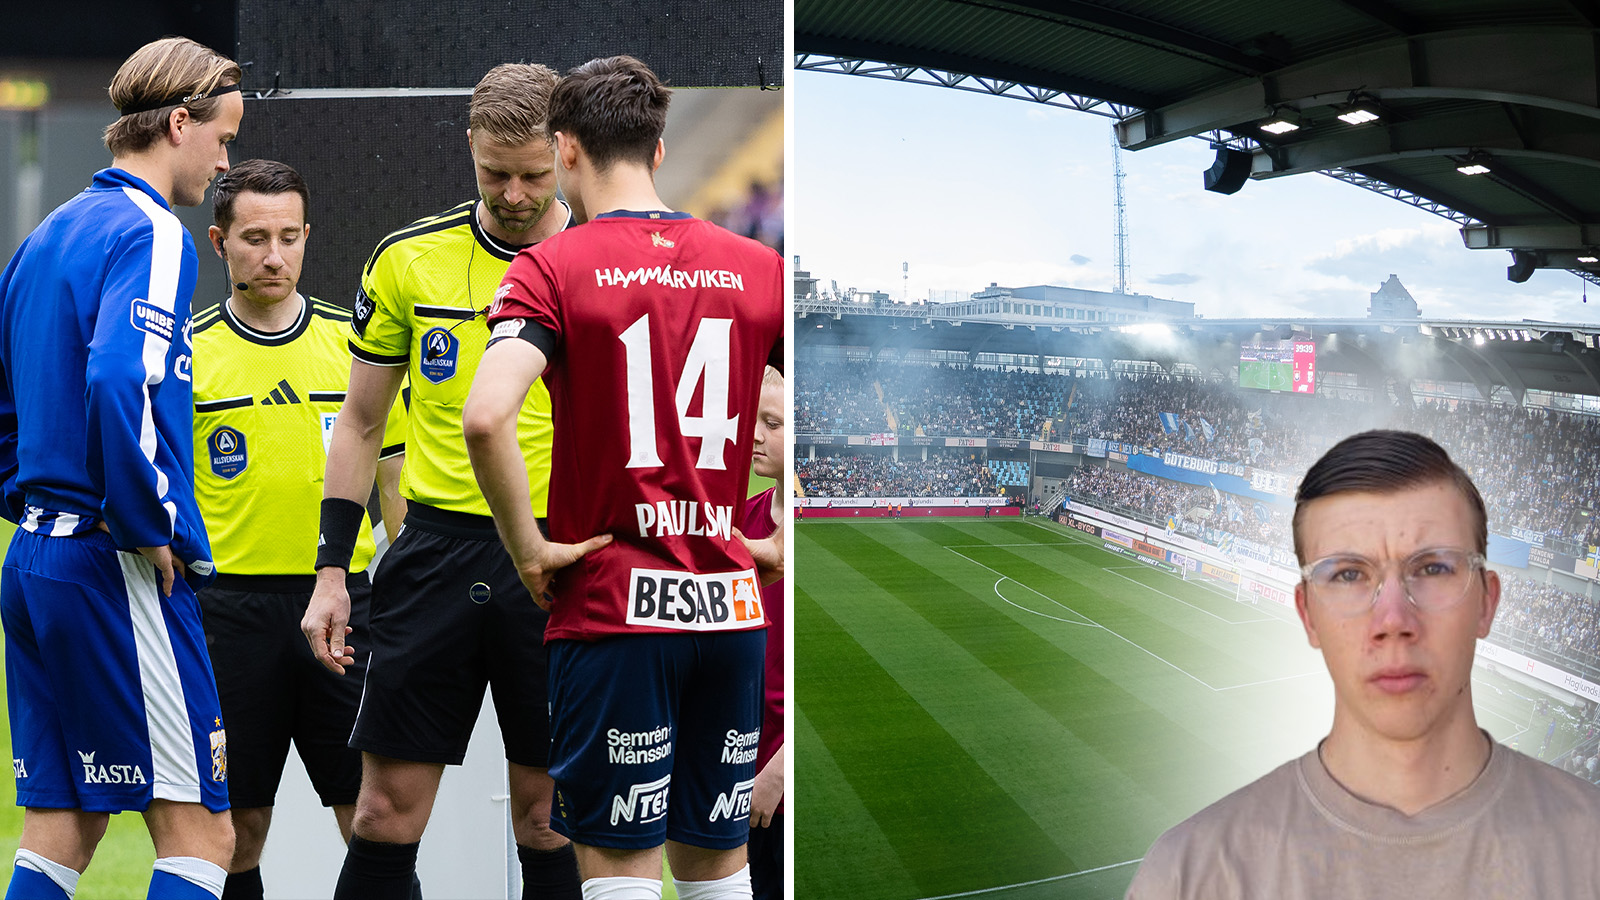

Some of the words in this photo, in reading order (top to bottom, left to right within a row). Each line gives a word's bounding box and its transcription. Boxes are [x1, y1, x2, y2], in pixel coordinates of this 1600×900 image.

[594, 264, 744, 291] HAMMARVIKEN
[136, 305, 175, 331] UNIBE
[618, 313, 740, 470] 14
[634, 575, 729, 624] BESAB
[608, 741, 672, 764] Månsson
[83, 764, 147, 784] RASTA
